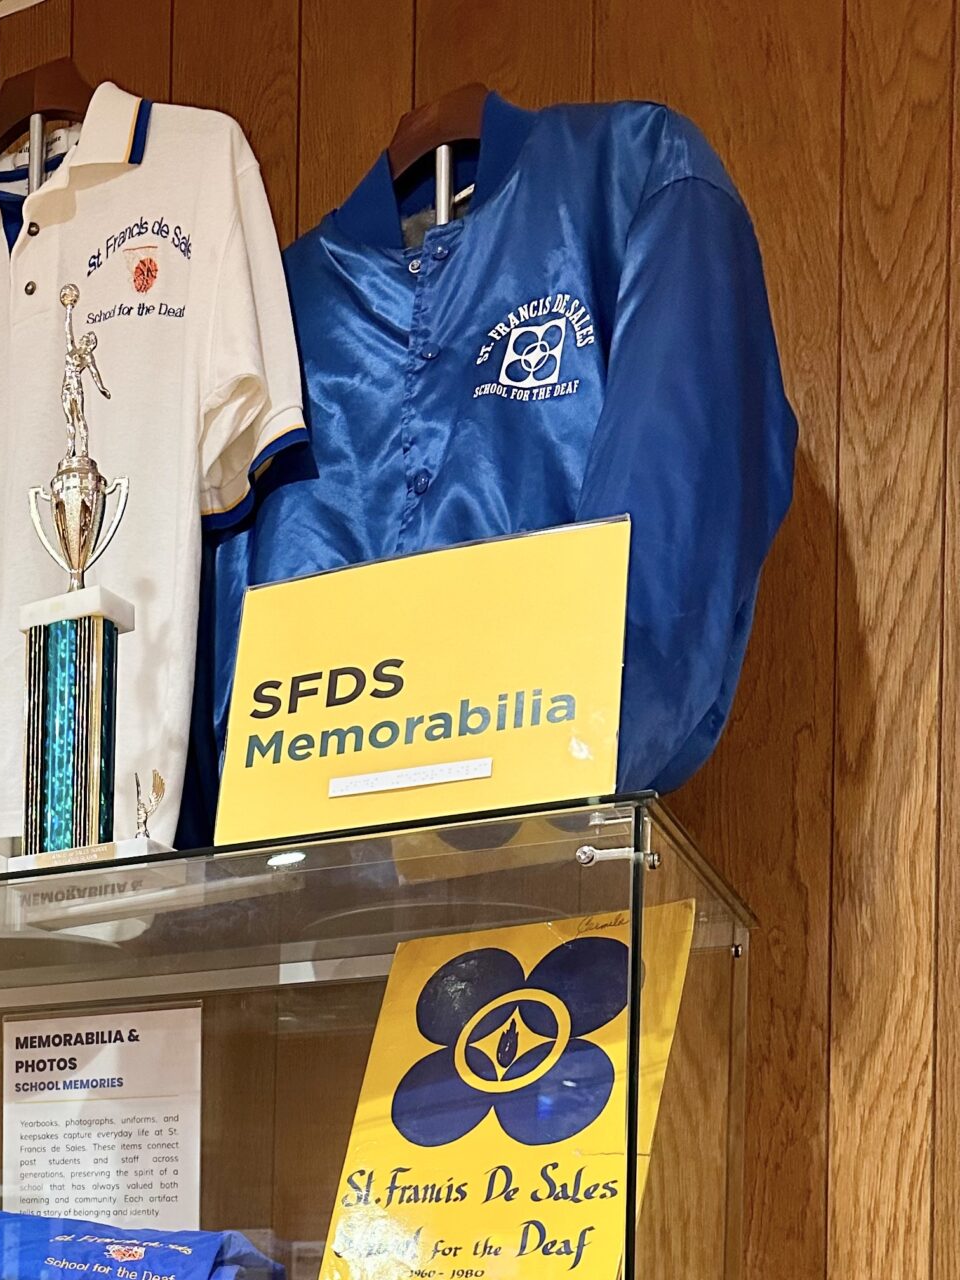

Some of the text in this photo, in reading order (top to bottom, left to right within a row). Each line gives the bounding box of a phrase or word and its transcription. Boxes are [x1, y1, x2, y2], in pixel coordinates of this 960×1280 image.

[87, 217, 169, 277] St Francis de
[86, 303, 185, 324] School for the Deaf
[477, 294, 594, 364] ST. FRANCIS DE SALES
[473, 380, 579, 401] SCHOOL FOR THE DEAF
[250, 658, 404, 719] SFDS
[245, 688, 577, 768] Memorabilia
[15, 1028, 140, 1050] MEMORABILIA &
[15, 1057, 77, 1073] PHOTOS
[15, 1078, 124, 1092] SCHOOL MEMORIES
[20, 1130, 132, 1141] keepsakes capture everyday
[71, 1170, 110, 1178] preserving
[134, 1169, 153, 1178] spirit
[482, 1165, 518, 1203] De
[531, 1162, 619, 1203] Sales
[92, 1182, 119, 1191] always
[20, 1196, 49, 1205] learning
[149, 1194, 178, 1202] artifact
[43, 1209, 61, 1218] story
[73, 1208, 110, 1218] belonging
[432, 1240, 461, 1258] for
[473, 1238, 501, 1257] the
[517, 1220, 595, 1271] Deaf
[44, 1257, 89, 1271] School
[92, 1263, 112, 1274] for
[117, 1266, 137, 1280] the
[450, 1269, 484, 1279] 1980
